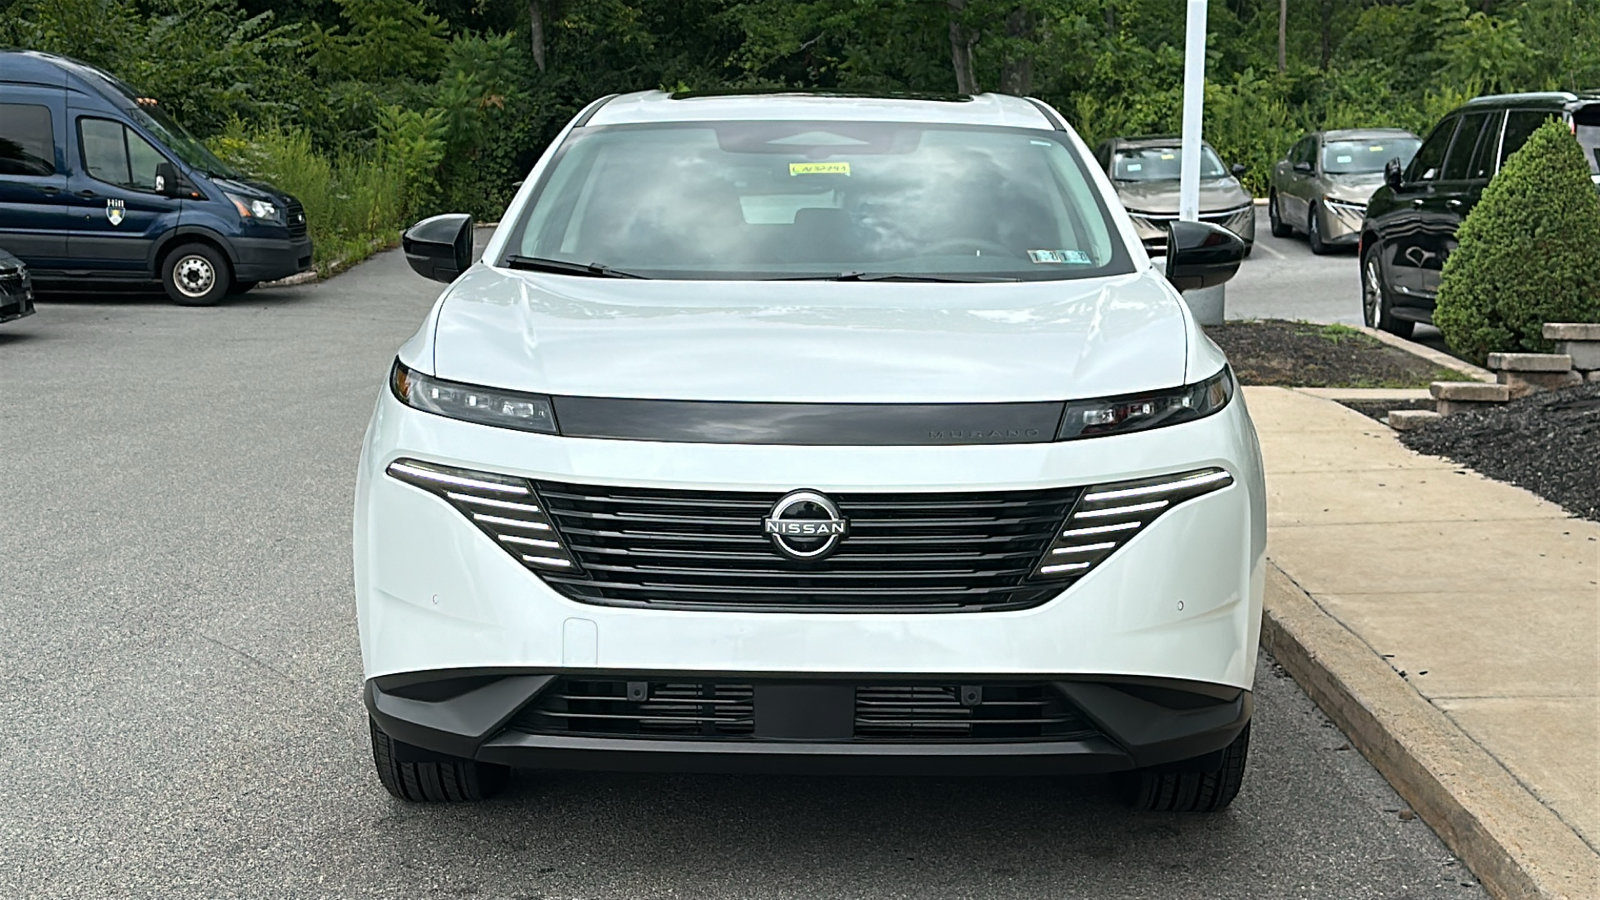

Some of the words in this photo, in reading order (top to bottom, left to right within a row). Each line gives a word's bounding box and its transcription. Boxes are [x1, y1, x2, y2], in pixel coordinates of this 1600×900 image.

[107, 198, 124, 207] Hill
[928, 428, 1040, 439] MURANO
[766, 521, 844, 534] NISSAN
